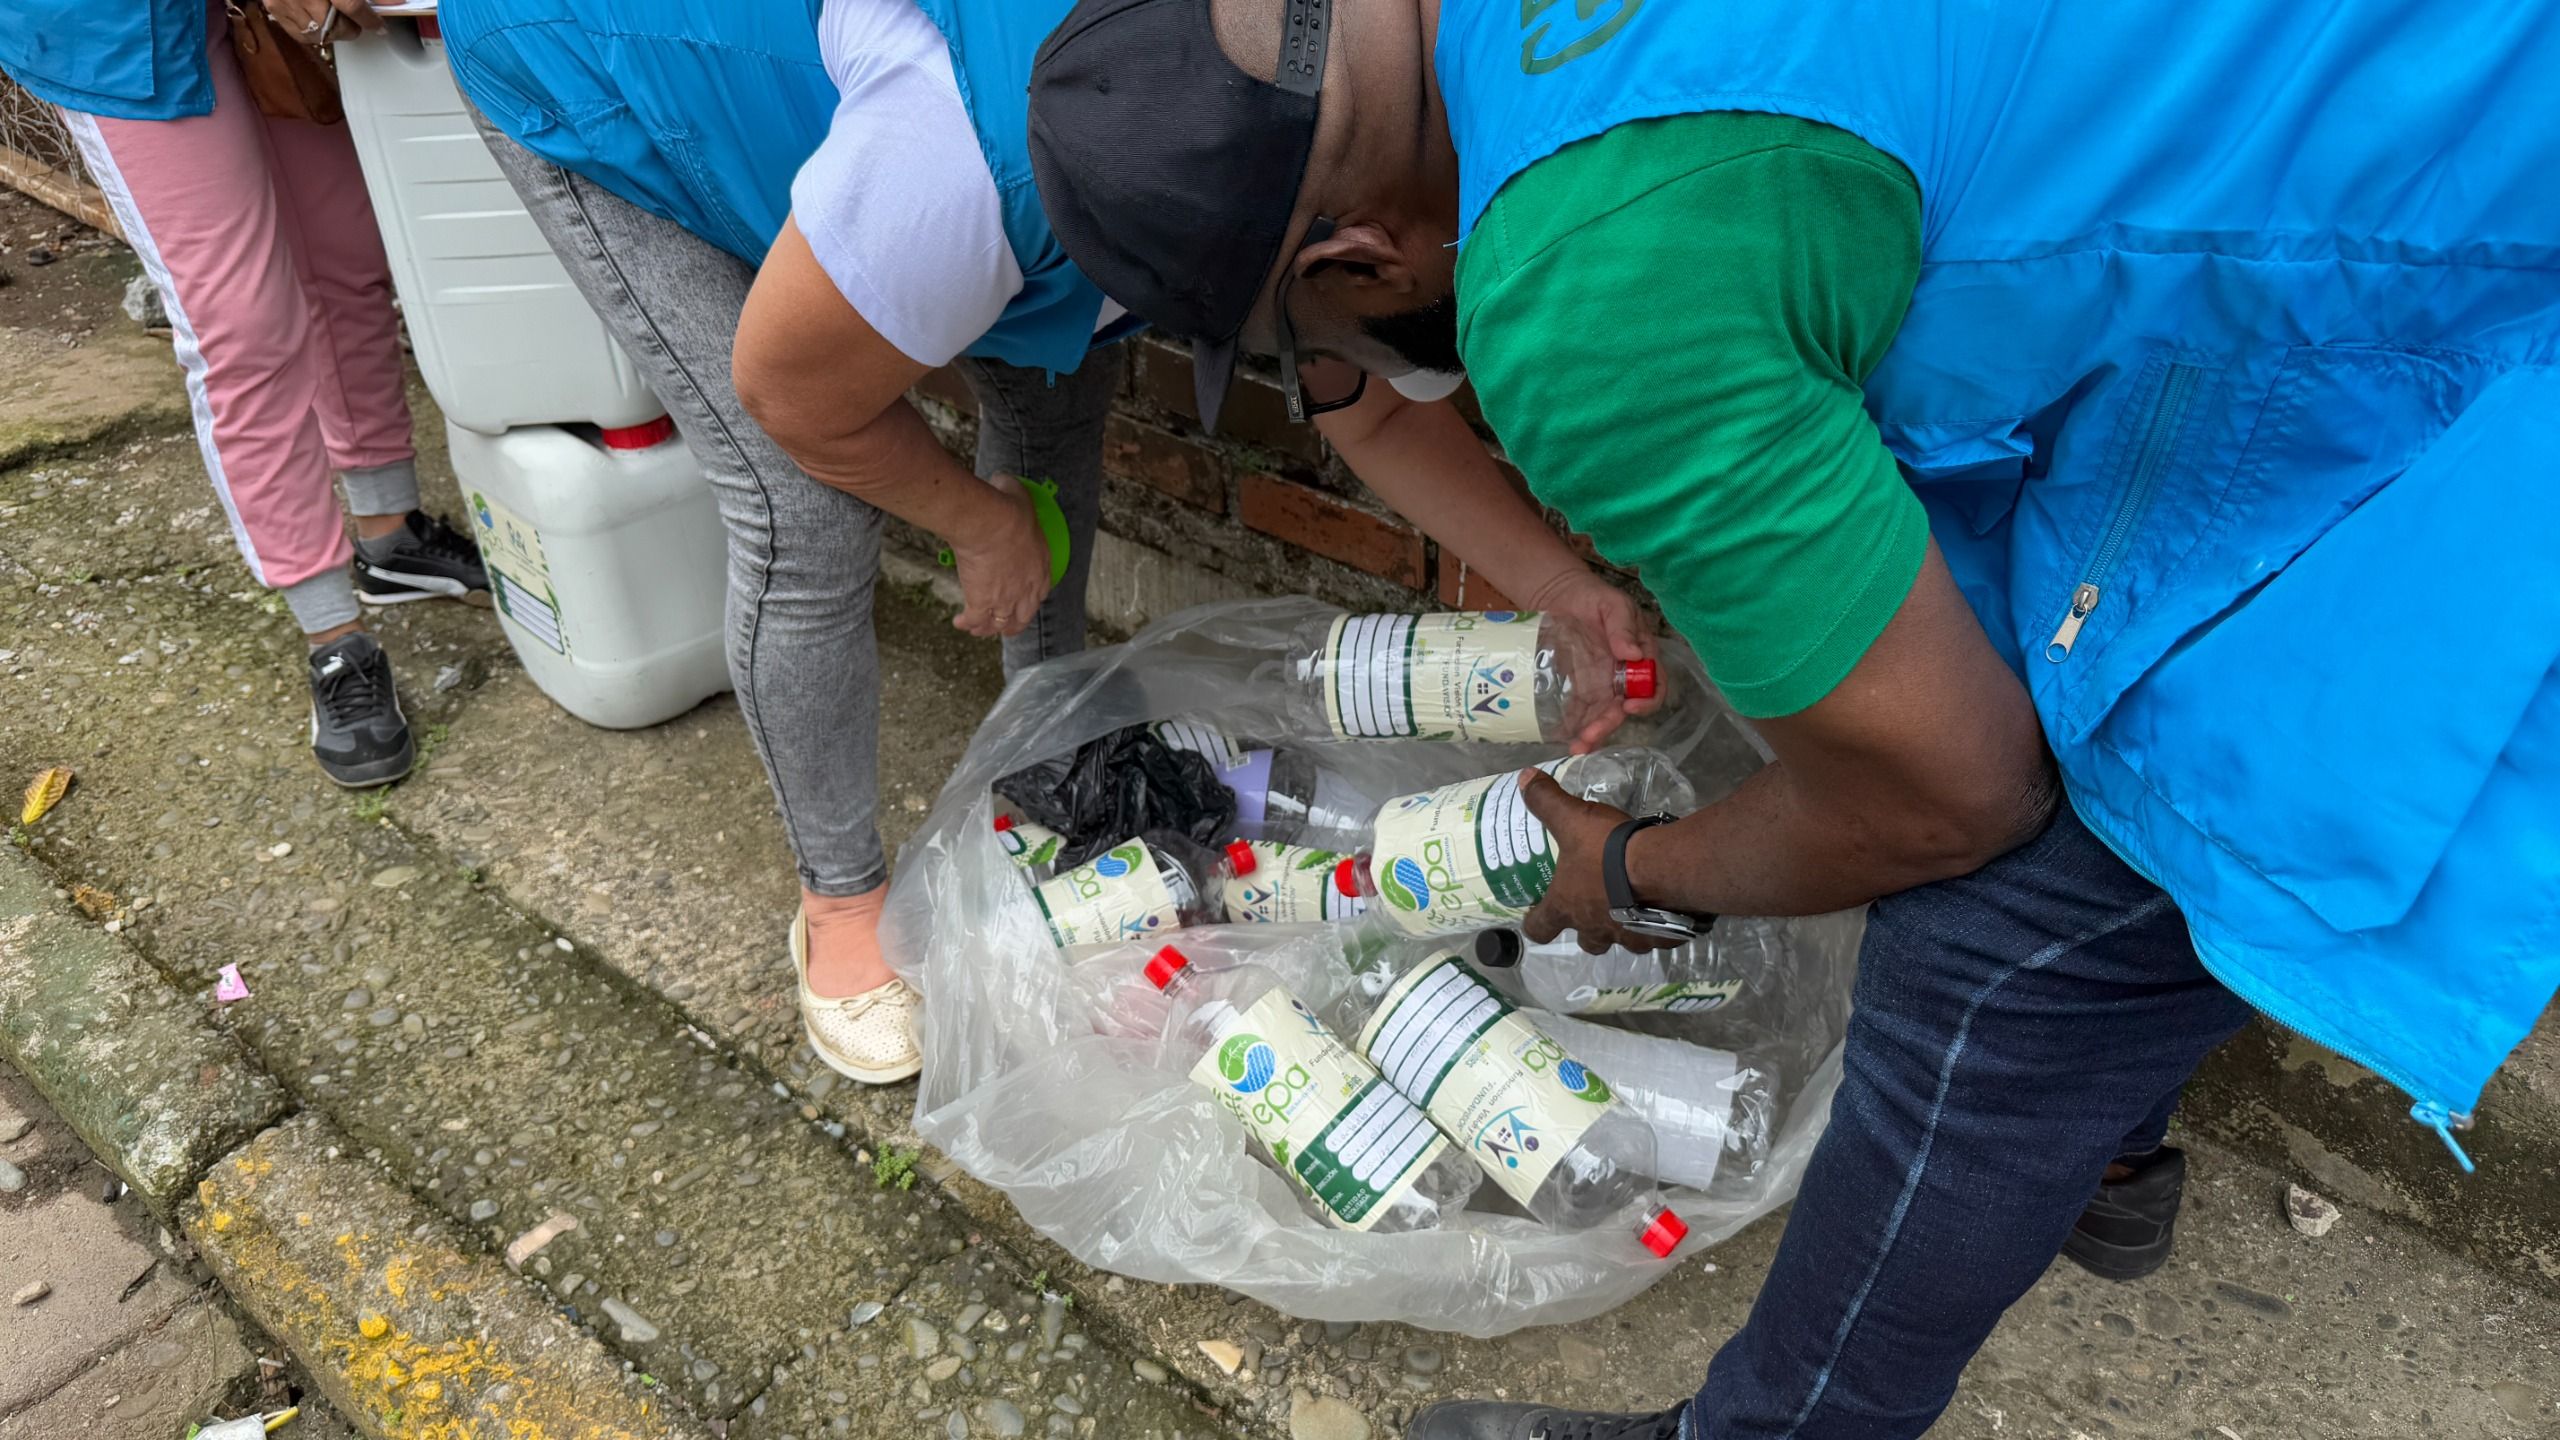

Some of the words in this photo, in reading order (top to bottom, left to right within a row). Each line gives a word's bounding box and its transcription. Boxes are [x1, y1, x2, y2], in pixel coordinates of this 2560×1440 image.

[1423, 838, 1463, 909] epa
[1252, 1061, 1310, 1125] epa
[1338, 1187, 1366, 1215] CANTIDAD
